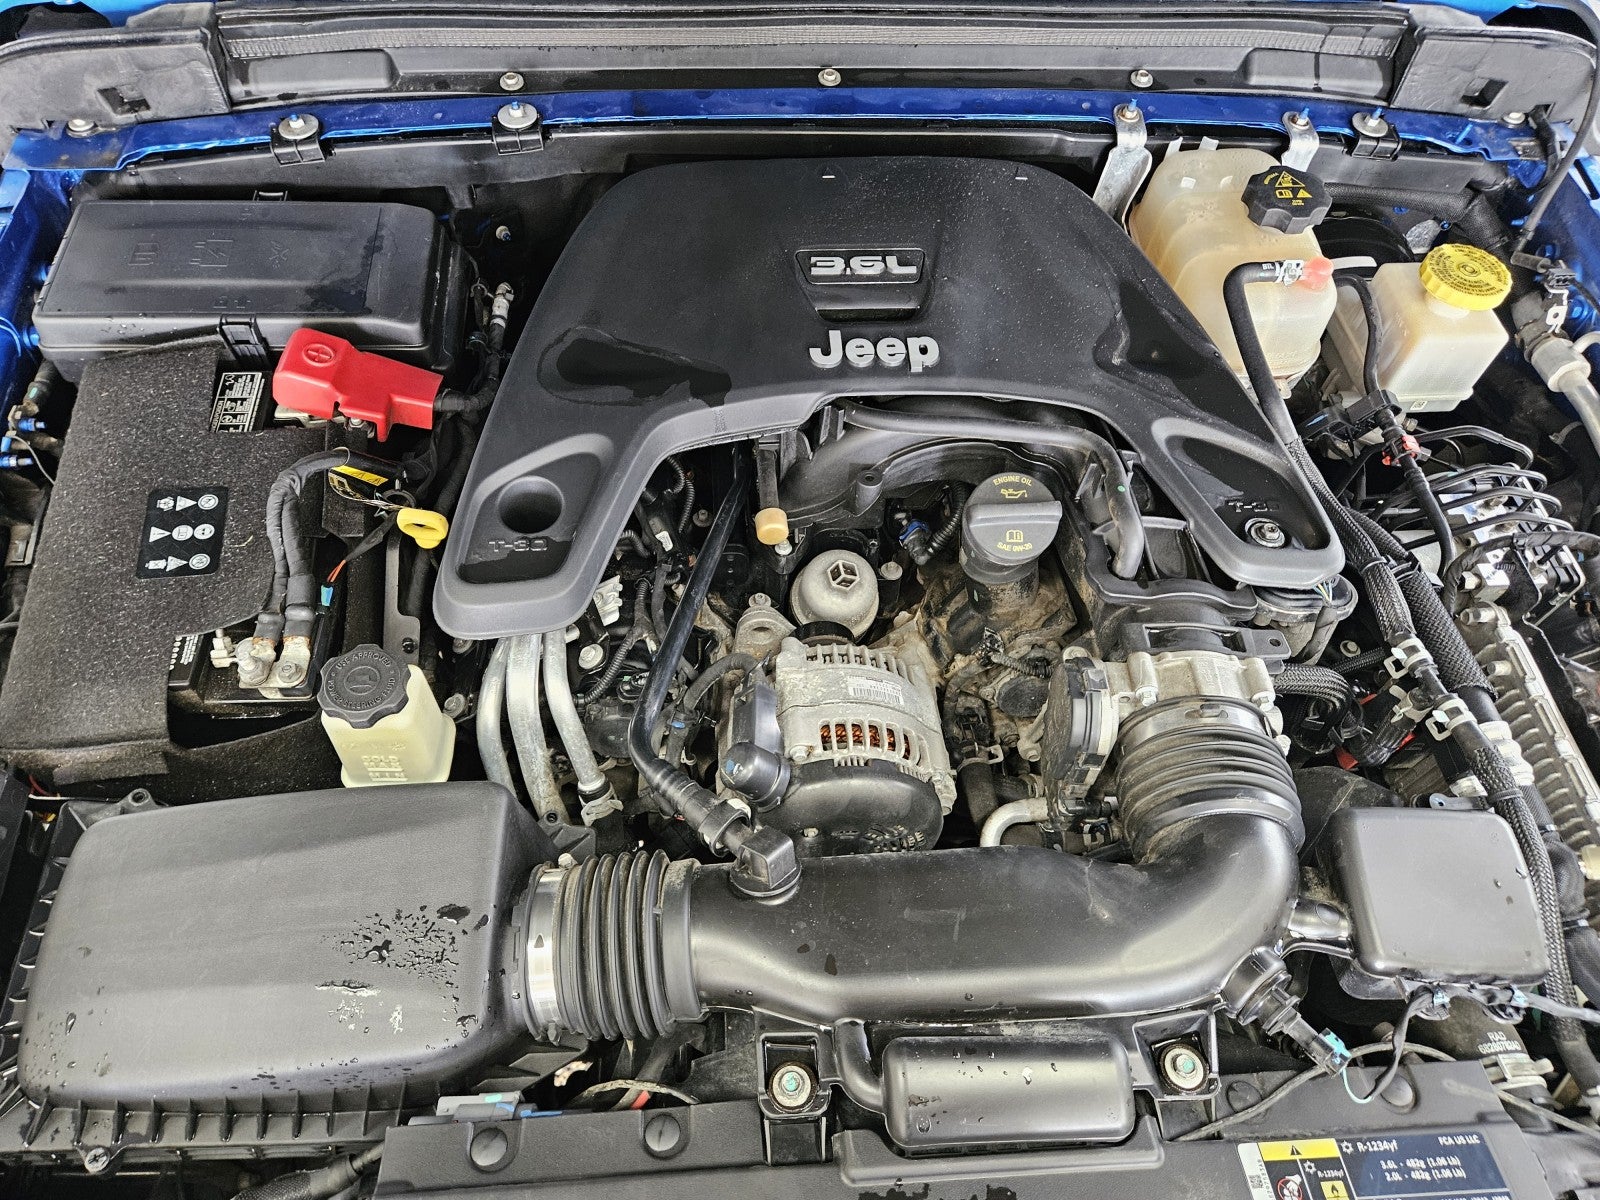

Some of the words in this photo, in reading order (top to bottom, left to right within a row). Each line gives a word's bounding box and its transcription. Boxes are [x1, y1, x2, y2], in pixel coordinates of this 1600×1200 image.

[810, 255, 917, 275] 3.6L
[809, 330, 940, 373] Jeep
[993, 475, 1020, 486] ENGINE
[1021, 476, 1033, 487] OIL
[488, 540, 548, 552] T-30
[997, 542, 1012, 552] SAE
[336, 656, 351, 670] USE
[352, 651, 392, 668] APPROVED
[327, 680, 342, 704] POWER
[381, 677, 396, 697] FLUID
[1486, 1031, 1507, 1041] RAD
[1356, 1139, 1398, 1152] R-1234yf
[1438, 1135, 1455, 1146] FCA
[1454, 1135, 1466, 1145] US
[1465, 1134, 1480, 1144] LLC
[1379, 1159, 1398, 1170] 3.6L
[1384, 1171, 1403, 1181] 2.0L
